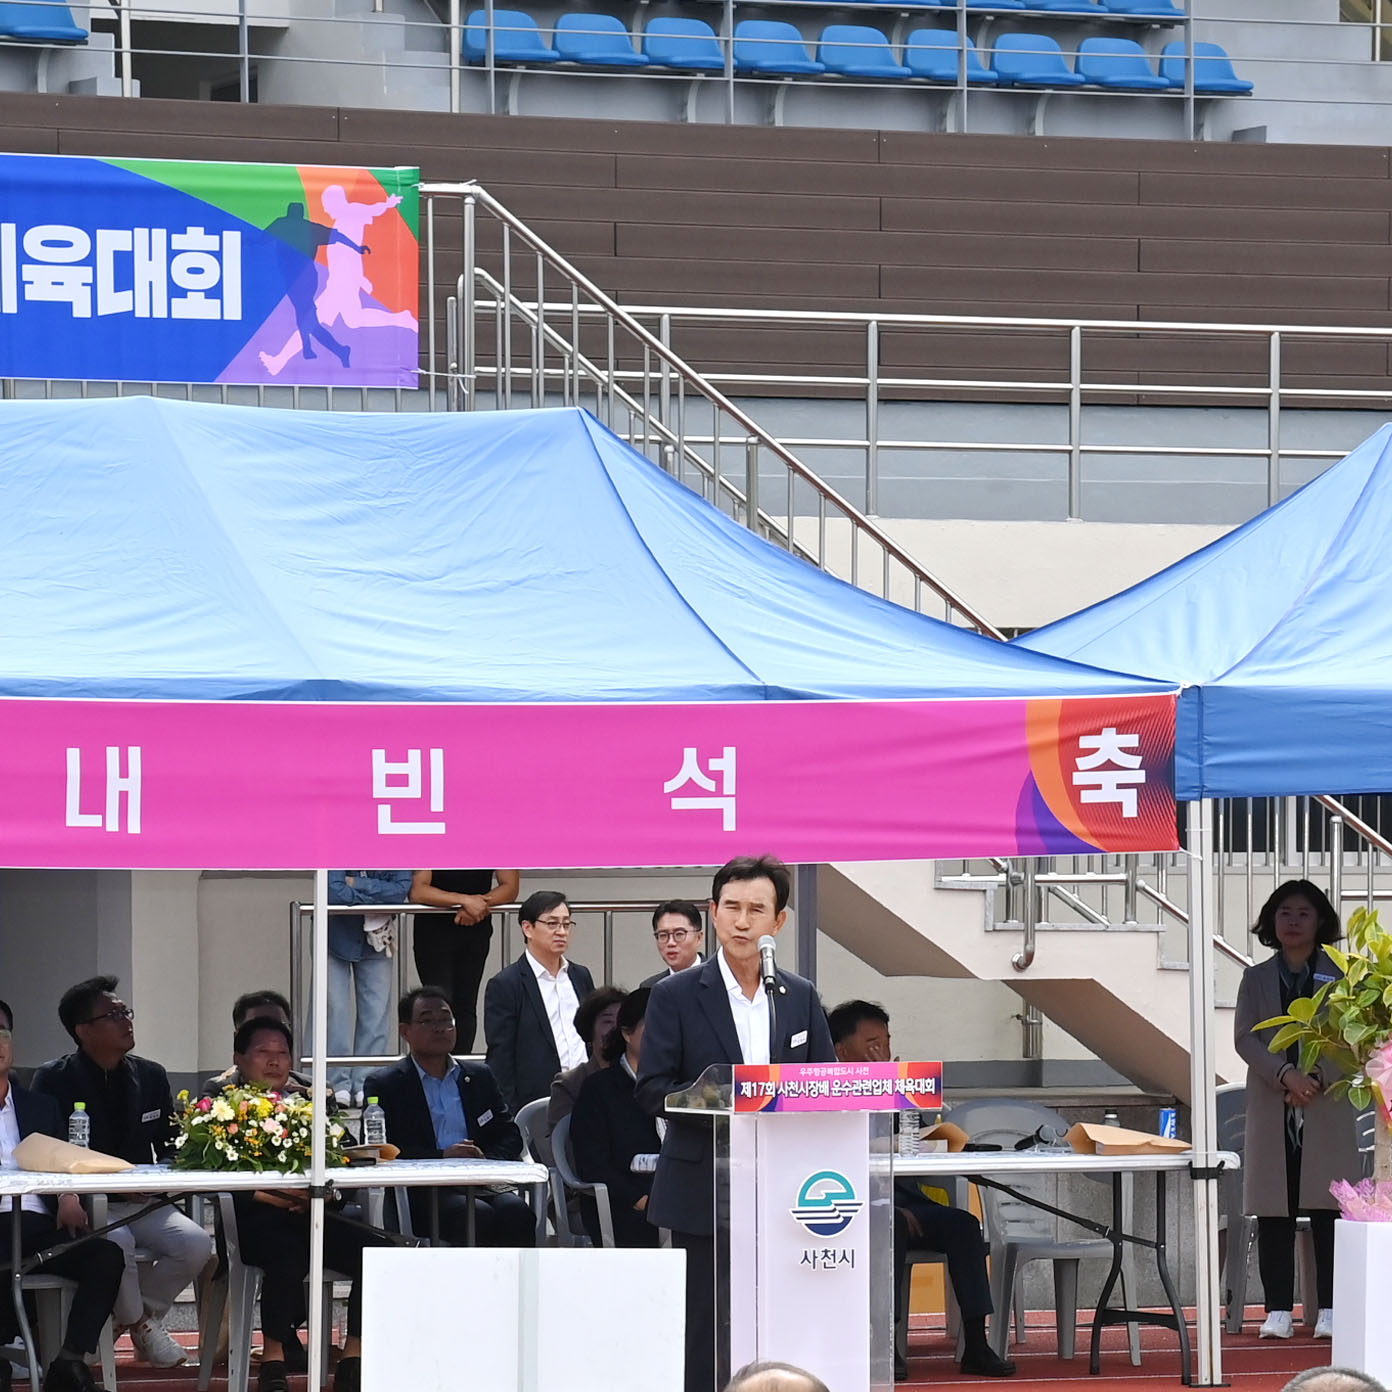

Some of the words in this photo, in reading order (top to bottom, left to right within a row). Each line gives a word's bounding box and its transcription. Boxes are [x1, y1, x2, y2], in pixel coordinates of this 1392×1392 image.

[1072, 727, 1146, 817] 축
[740, 1080, 776, 1098] 제17회
[777, 1080, 830, 1098] 사천시장배
[831, 1079, 893, 1098] 운수관련업체
[894, 1078, 936, 1095] 체육대회
[799, 1248, 856, 1270] 사천시
